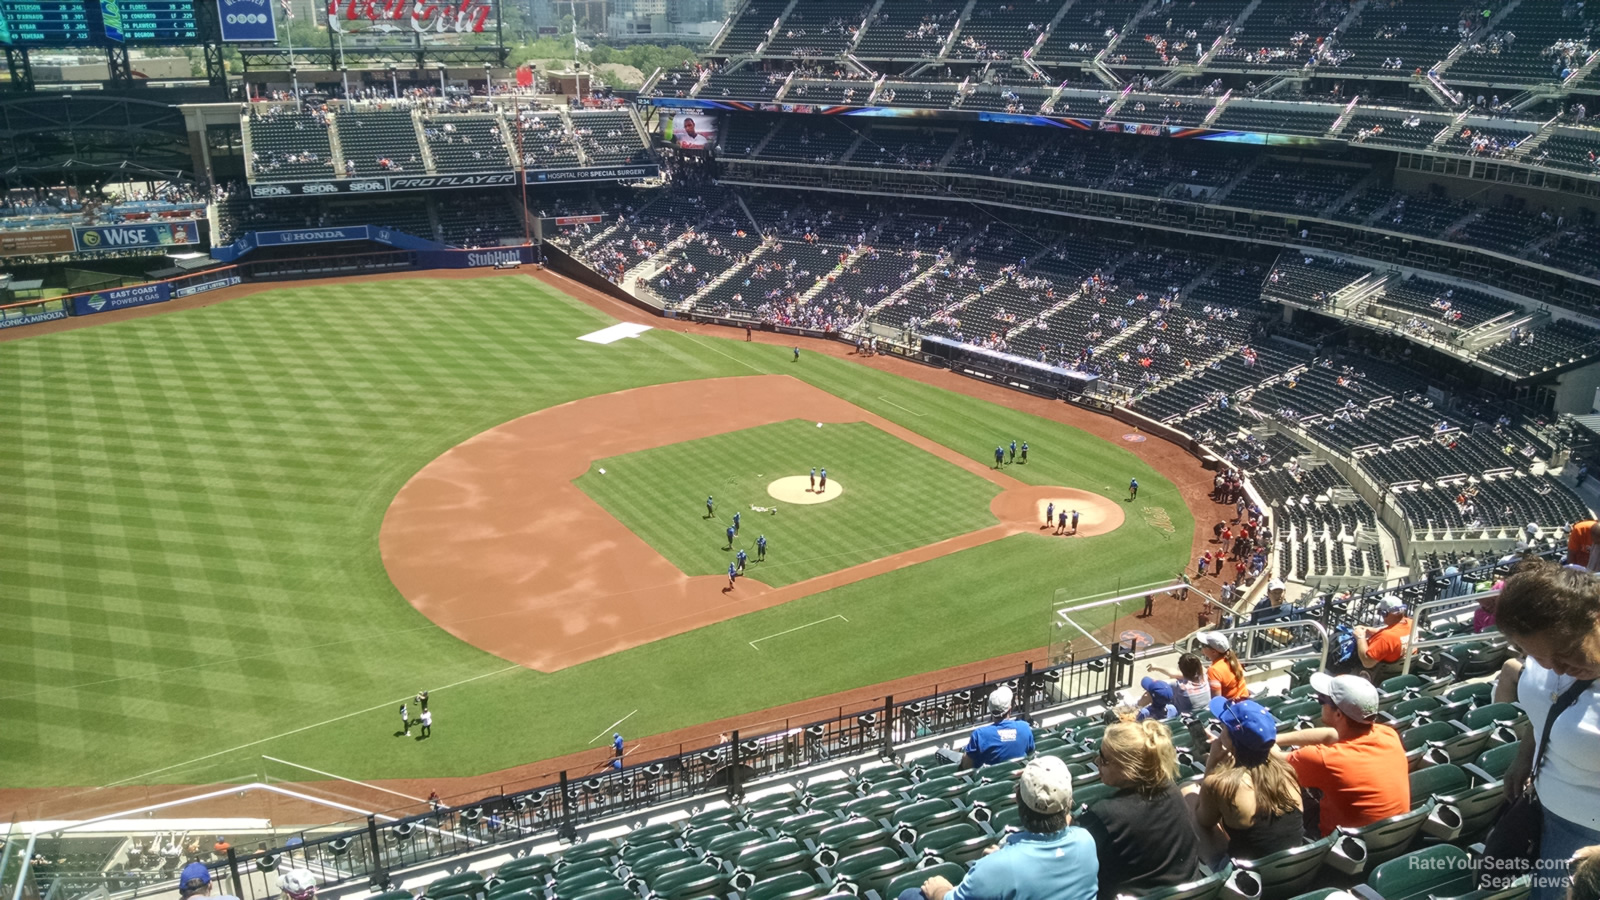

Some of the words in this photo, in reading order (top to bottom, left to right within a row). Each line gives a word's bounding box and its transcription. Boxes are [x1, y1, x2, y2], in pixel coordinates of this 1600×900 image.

[392, 179, 435, 187] PRO
[437, 175, 513, 185] PLAYER
[104, 228, 150, 246] WISE
[294, 230, 346, 241] HONDA
[468, 250, 520, 266] StubHub!
[110, 290, 130, 299] EAST
[132, 286, 157, 296] COAST
[112, 297, 138, 306] POWER
[0, 317, 30, 327] KONICA
[31, 311, 64, 323] MINOLTA
